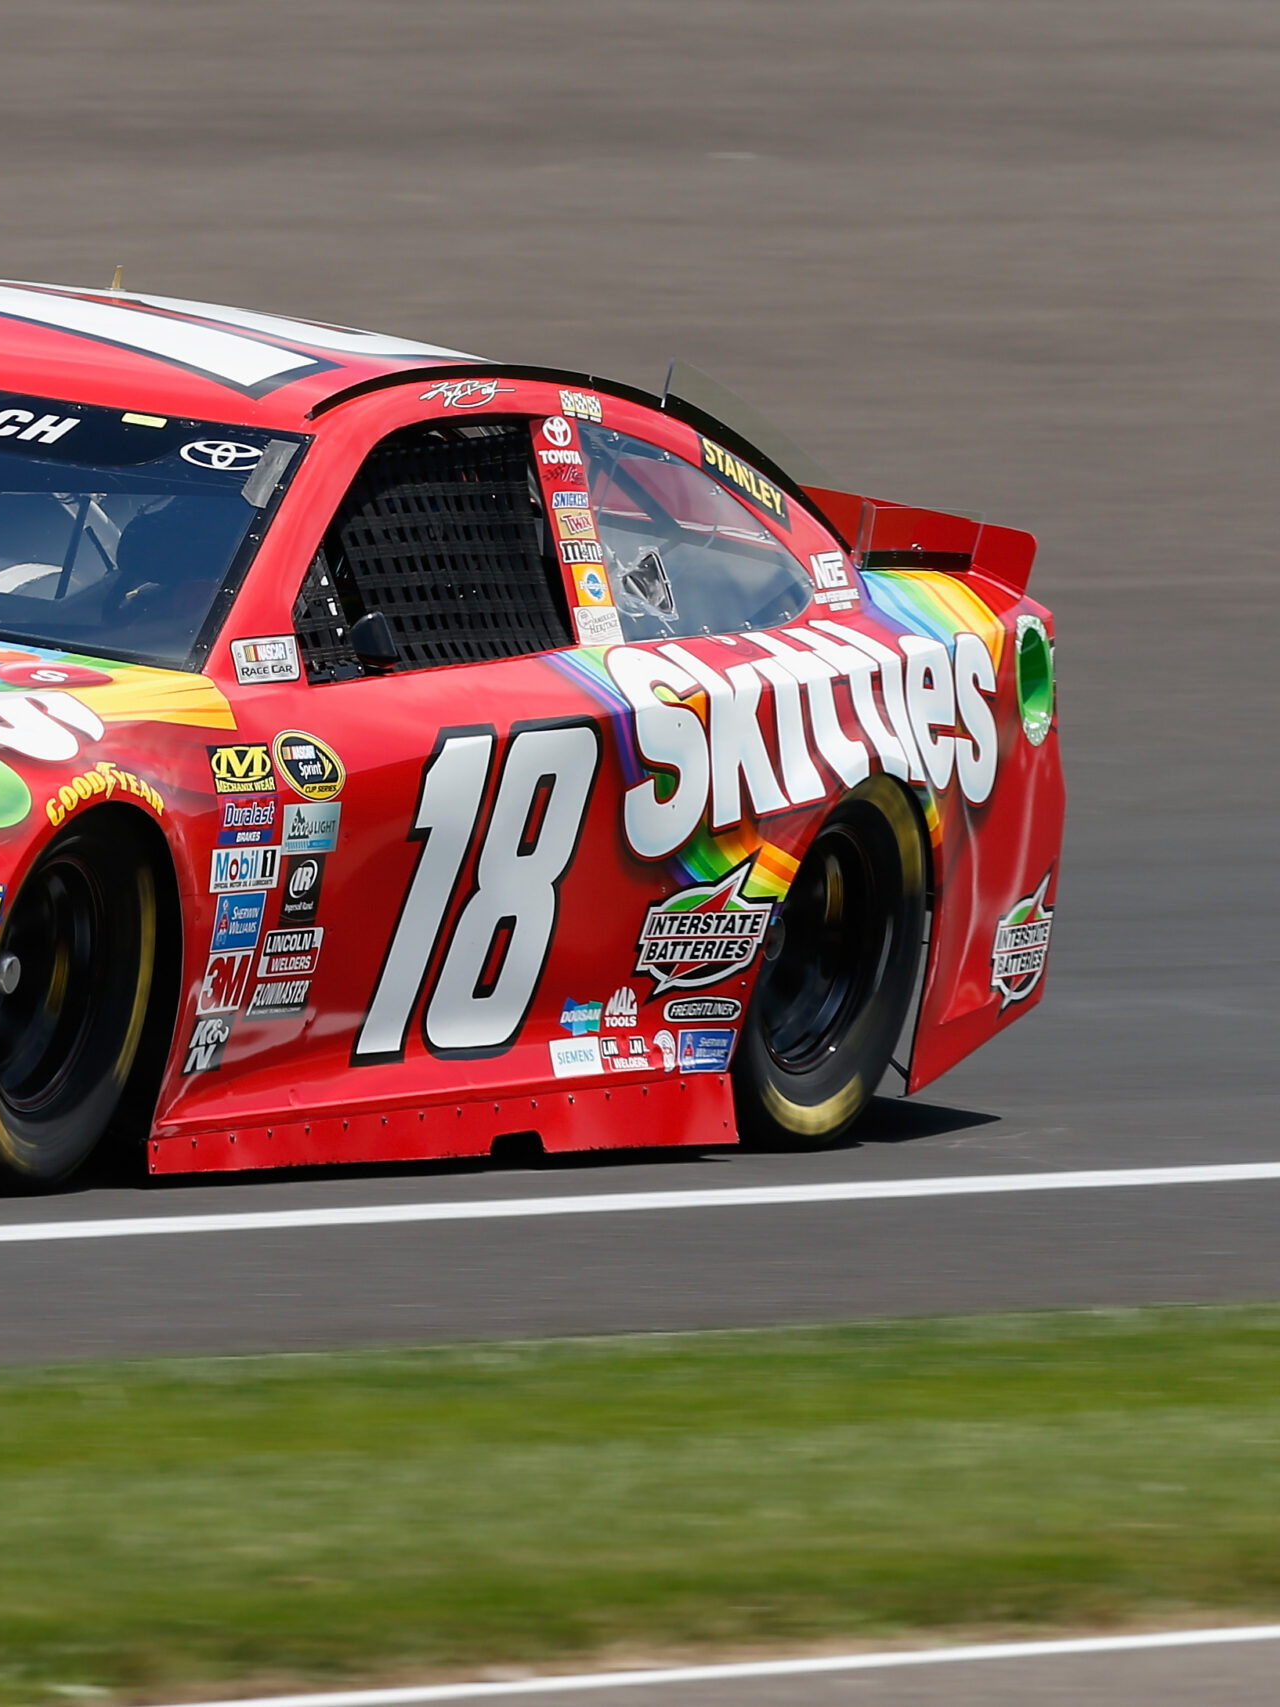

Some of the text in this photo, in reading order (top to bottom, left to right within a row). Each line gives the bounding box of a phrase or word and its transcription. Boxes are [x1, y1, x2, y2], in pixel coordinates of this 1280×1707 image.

[538, 449, 583, 465] TOYOTA
[701, 436, 784, 516] STANLEY
[554, 492, 588, 507] SNICKERS
[809, 550, 849, 590] NOS
[257, 642, 288, 661] NASCAR
[604, 619, 998, 859] Skittles
[298, 761, 324, 780] Sprint
[46, 761, 165, 827] GOODYEAR
[215, 776, 276, 794] MECHANIX WEAR
[304, 784, 338, 793] CUP SERIES
[223, 801, 275, 827] Duralast
[314, 819, 337, 835] LIGHT
[235, 831, 261, 843] BRAKES
[214, 850, 259, 883] Mobil
[356, 726, 600, 1056] 18
[228, 921, 258, 935] WILLIAMS
[646, 912, 764, 937] INTERSTATE
[264, 932, 313, 954] LINCOLN
[997, 922, 1050, 950] INTERSTATE
[644, 938, 752, 962] BATTERIES
[270, 955, 312, 972] WELDERS
[995, 949, 1044, 976] BATTERIES
[200, 956, 251, 1010] 3M
[245, 980, 309, 1017] FLOWMASTER
[604, 986, 638, 1016] MAC
[560, 1008, 602, 1024] DOOSAN
[669, 1003, 736, 1016] FREIGHTLINER
[604, 1016, 638, 1028] TOOLS
[556, 1049, 595, 1065] SIEMENS
[602, 1039, 643, 1056] LINLN
[612, 1056, 649, 1069] WELDERS
